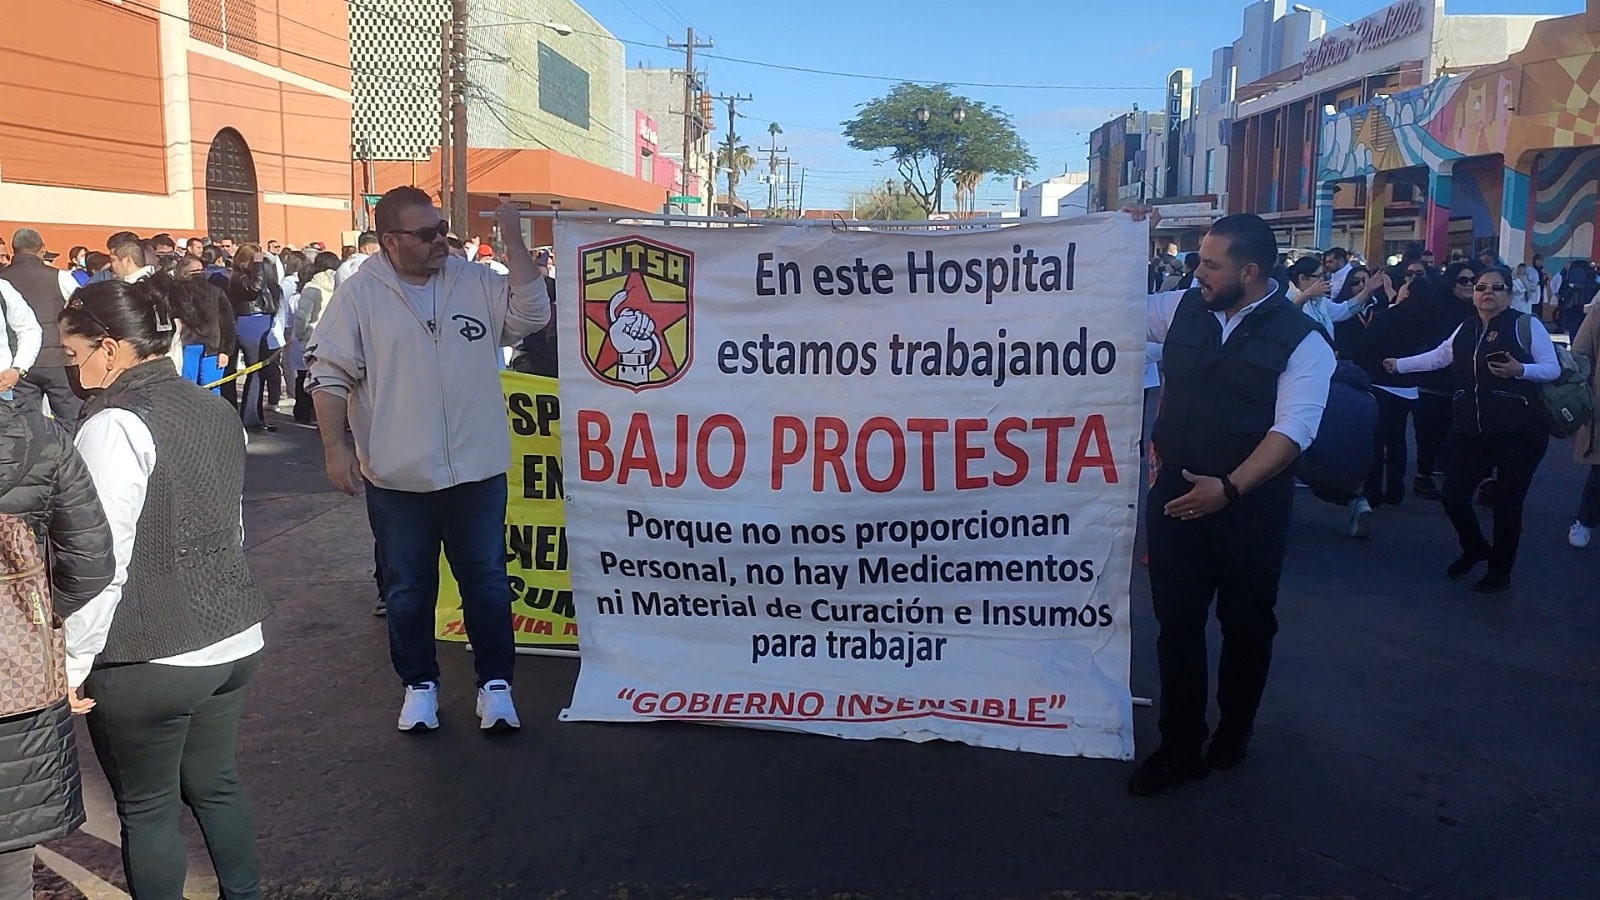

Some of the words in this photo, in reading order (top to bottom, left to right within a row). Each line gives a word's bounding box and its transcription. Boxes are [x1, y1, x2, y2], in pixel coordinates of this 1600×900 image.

[1171, 83, 1181, 131] LUX
[585, 244, 686, 283] SNTSA
[755, 252, 802, 297] En
[812, 257, 894, 296] este
[907, 242, 1076, 305] Hospital
[717, 333, 877, 376] estamos
[889, 326, 1117, 388] trabajando
[577, 409, 745, 489] BAJO
[770, 414, 1118, 493] PROTESTA
[626, 509, 733, 549] Porque
[742, 522, 781, 545] no
[790, 524, 846, 545] nos
[855, 509, 1070, 550] proporcionan
[600, 551, 737, 587] Personal,
[746, 563, 784, 586] no
[793, 556, 849, 591] hay
[596, 588, 624, 615] ni
[631, 591, 757, 617] Material
[765, 596, 802, 620] de
[810, 597, 944, 624] Curación
[954, 605, 972, 625] e
[982, 599, 1113, 628] Insumos
[752, 633, 817, 664] para
[825, 628, 948, 668] trabajar
